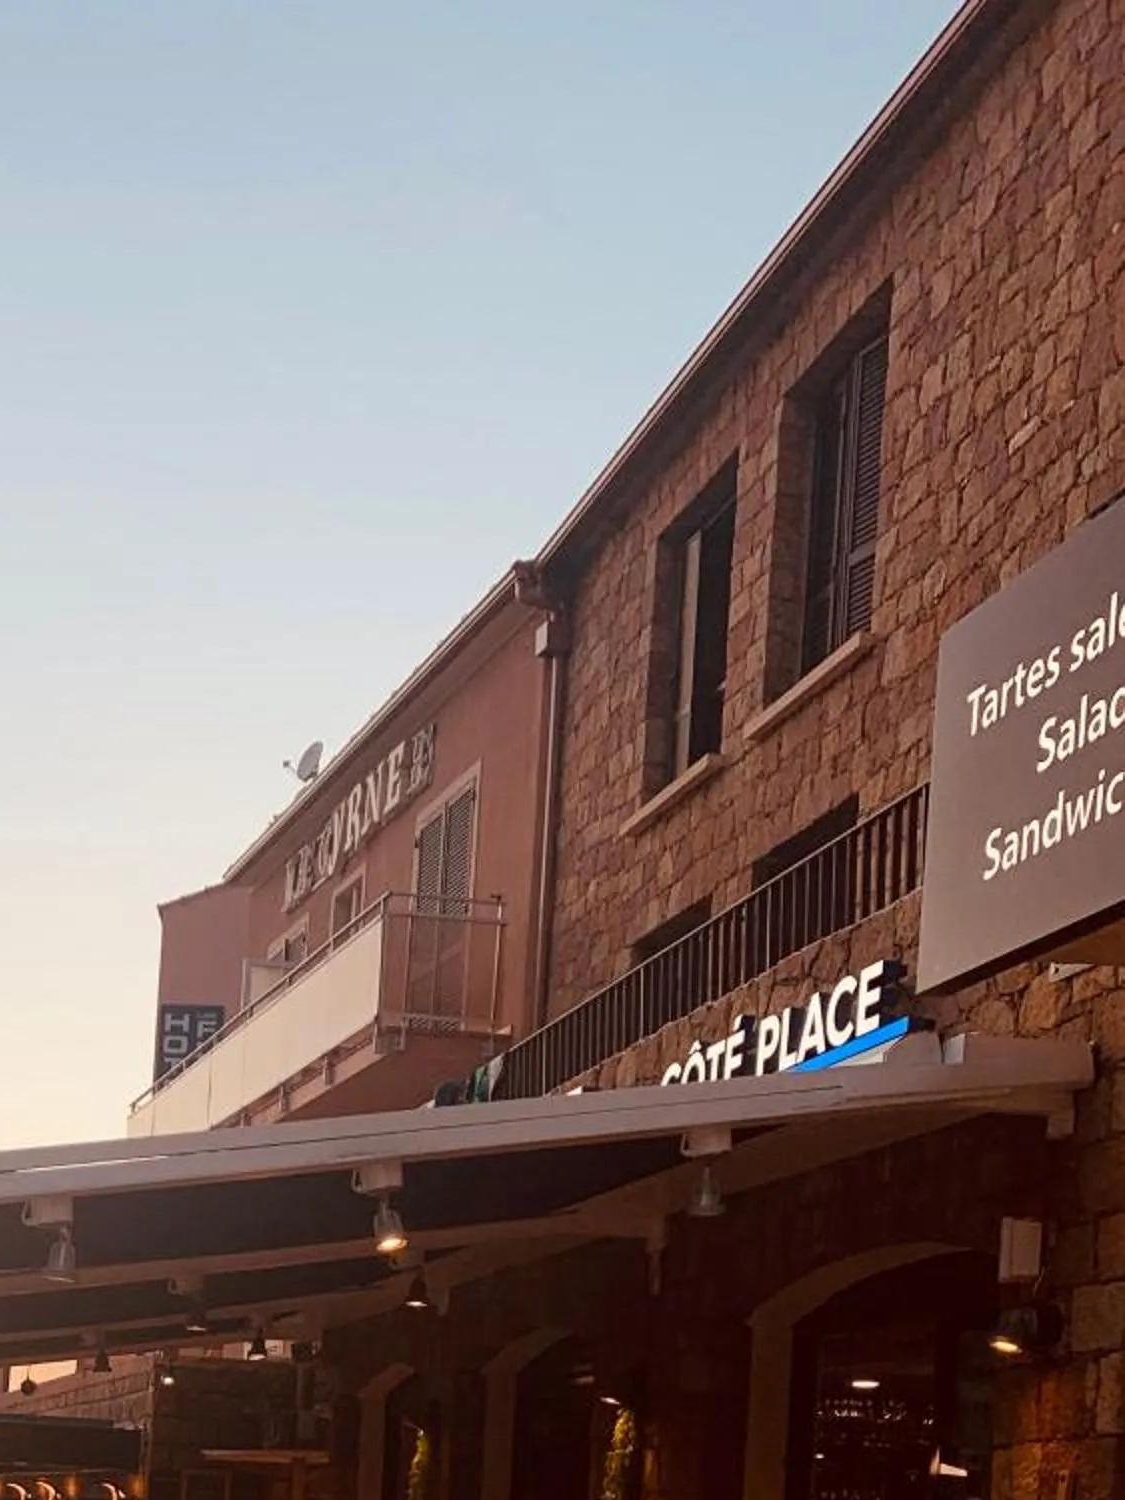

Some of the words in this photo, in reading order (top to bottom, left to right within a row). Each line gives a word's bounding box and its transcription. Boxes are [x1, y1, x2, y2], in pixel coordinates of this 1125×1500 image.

[965, 643, 1062, 737] Tartes
[982, 768, 1125, 881] Sandwic
[755, 959, 885, 1077] PLACE
